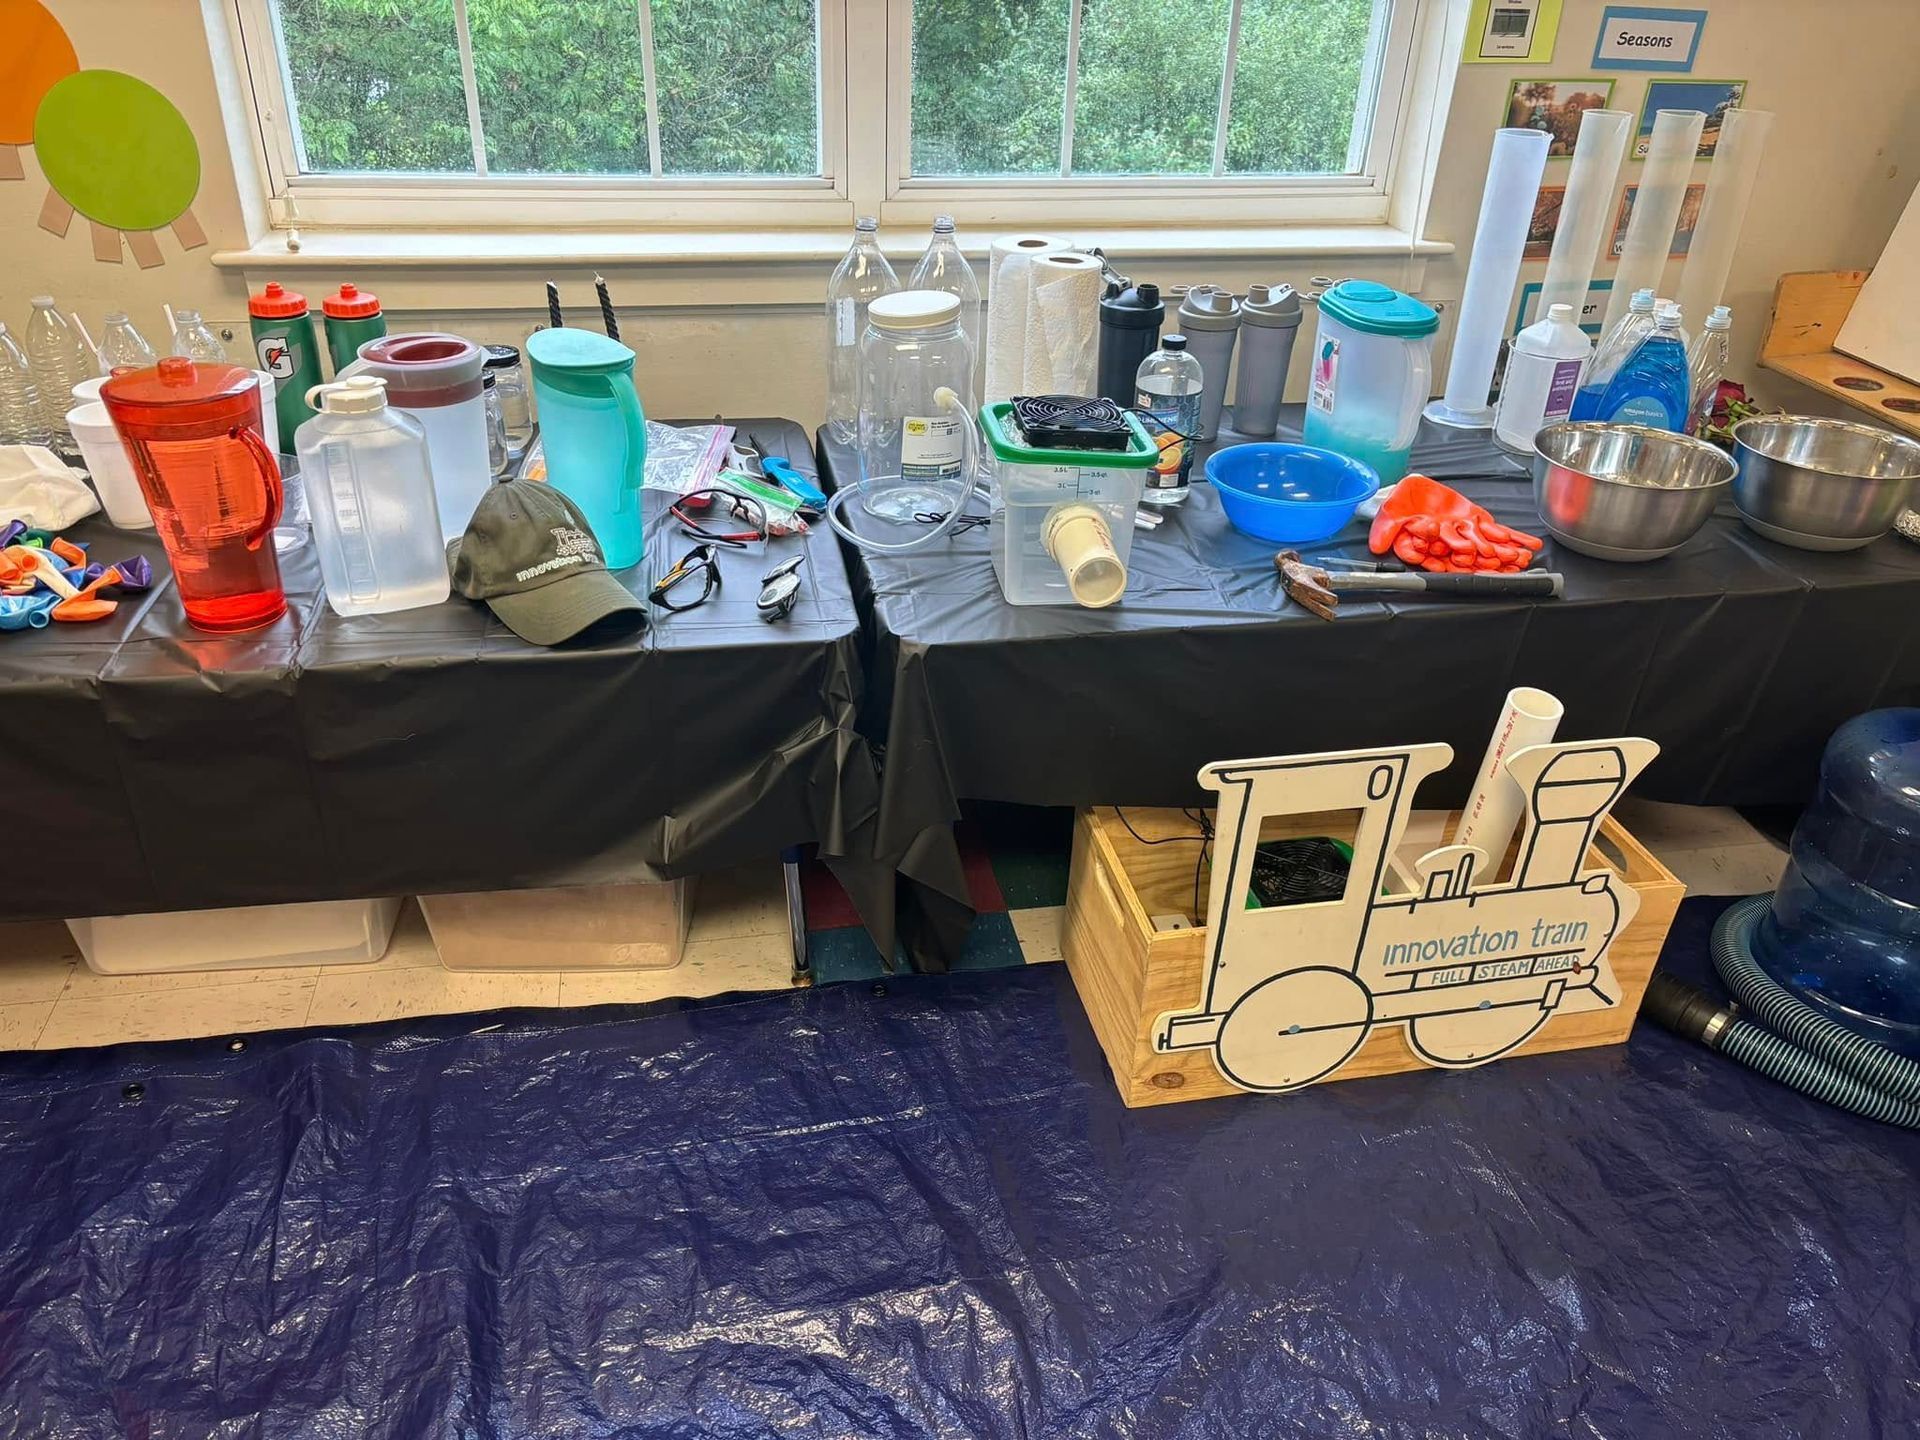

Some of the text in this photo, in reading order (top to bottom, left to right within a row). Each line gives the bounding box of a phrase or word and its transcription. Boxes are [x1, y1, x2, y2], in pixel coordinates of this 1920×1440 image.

[1616, 31, 1673, 48] Seasons
[1382, 918, 1589, 967] innovation train
[1431, 968, 1467, 985] FULL
[1478, 959, 1530, 979] STEAM
